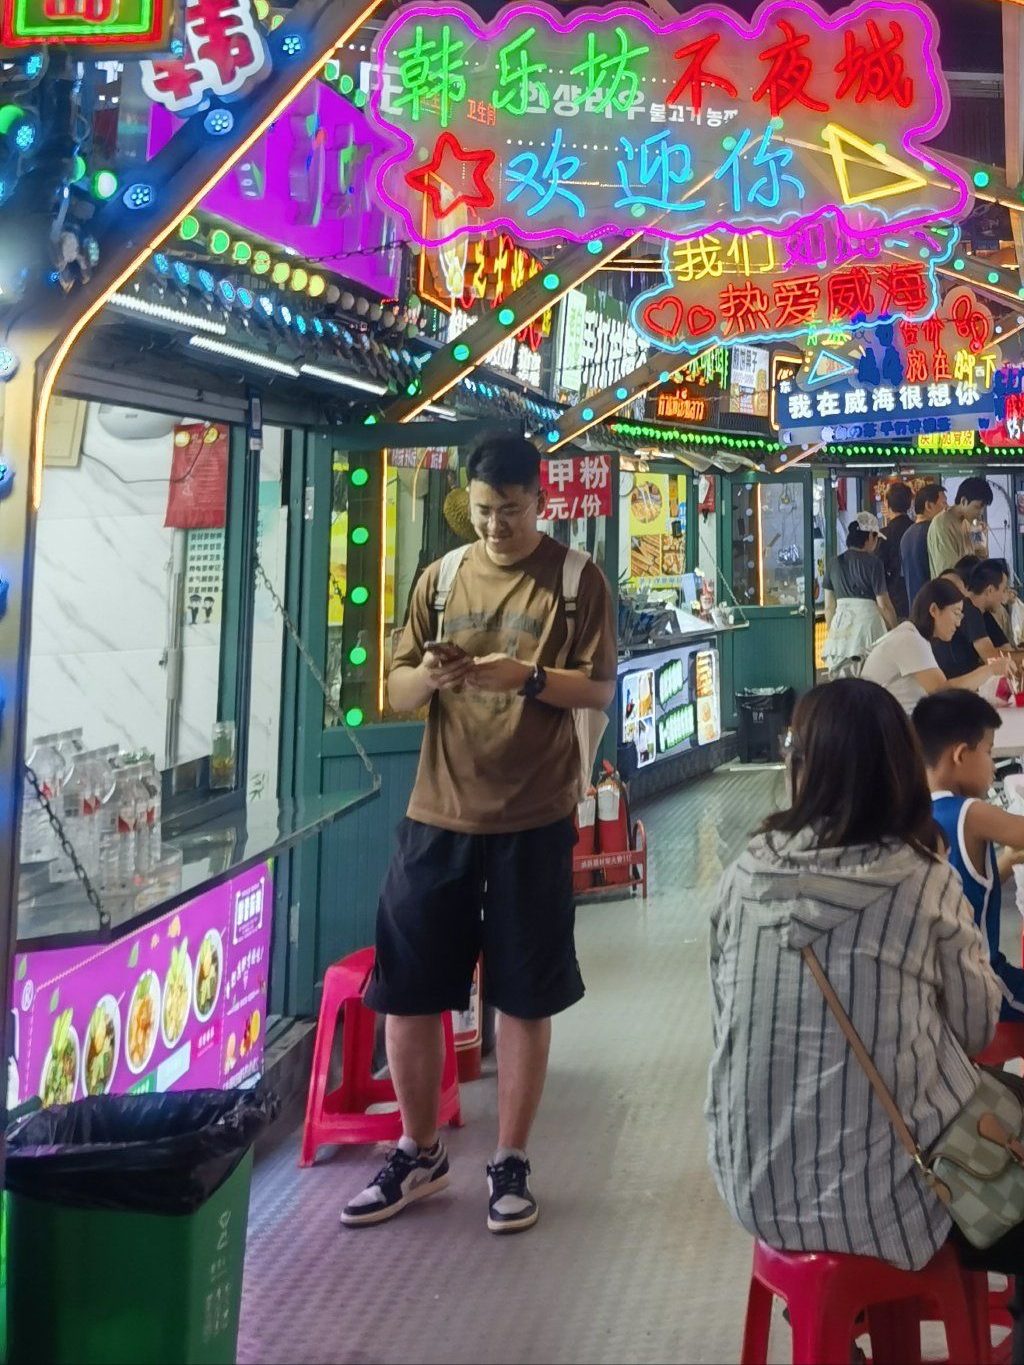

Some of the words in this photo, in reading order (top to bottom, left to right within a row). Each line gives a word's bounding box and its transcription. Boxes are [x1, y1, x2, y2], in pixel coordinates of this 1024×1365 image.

[400, 19, 913, 127] 韩乐坊不夜城
[506, 128, 806, 221] 欢迎你
[718, 263, 930, 336] 热爱威海
[788, 382, 980, 420] 我在威海很想你
